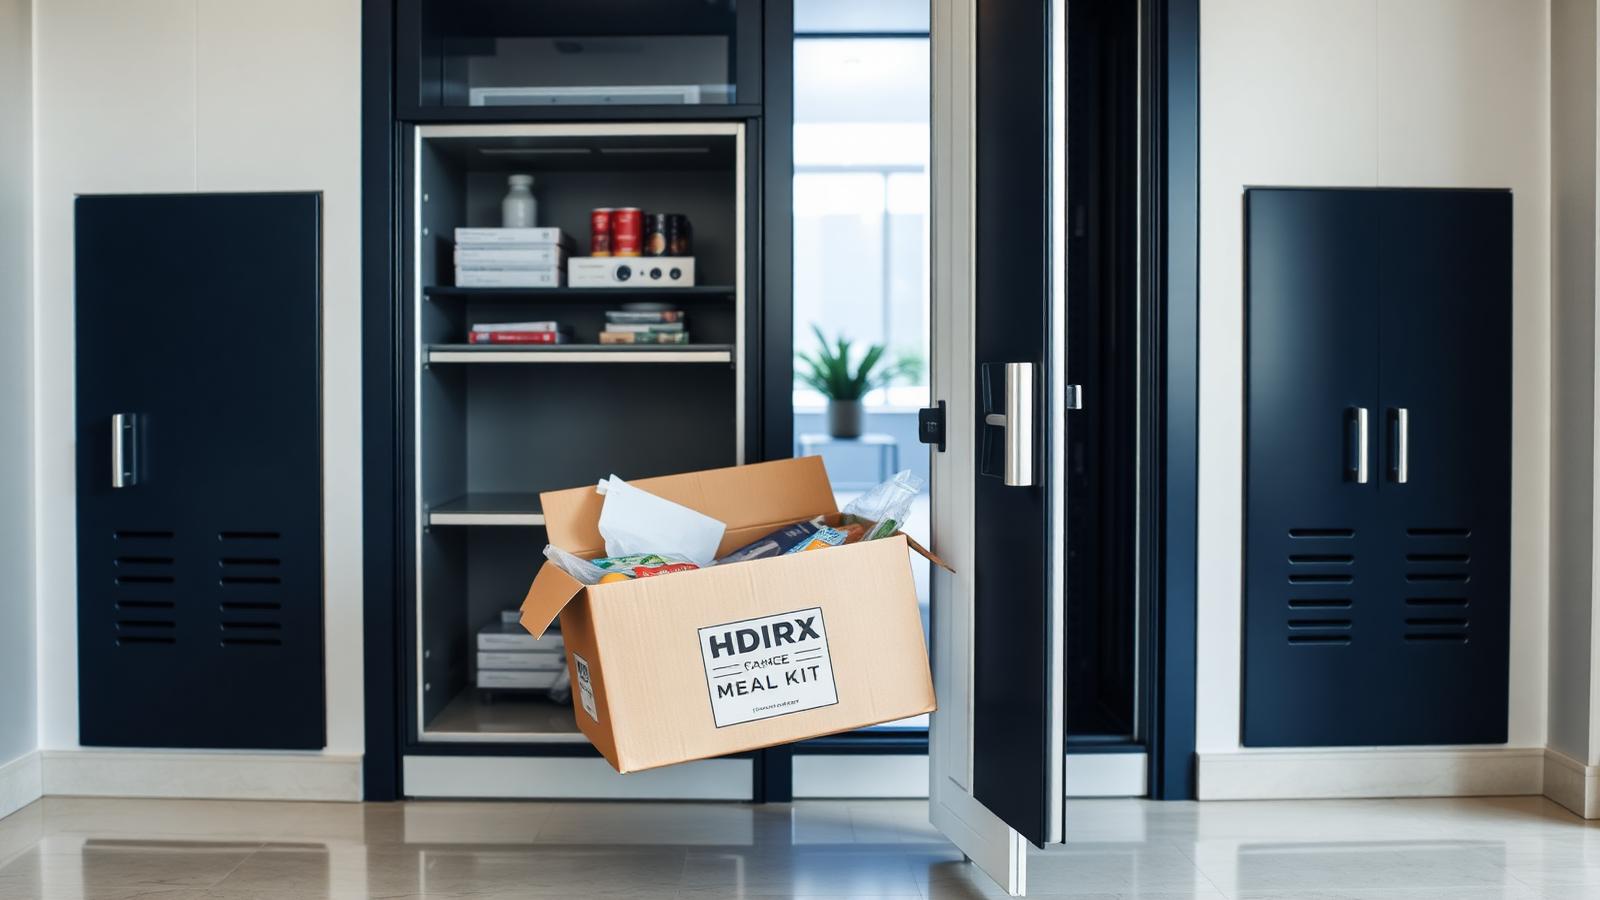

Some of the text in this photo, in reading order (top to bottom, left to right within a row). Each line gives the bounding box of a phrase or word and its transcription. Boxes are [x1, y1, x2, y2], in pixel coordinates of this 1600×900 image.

[709, 616, 821, 659] HDIRX
[717, 665, 820, 699] MEAL KIT
